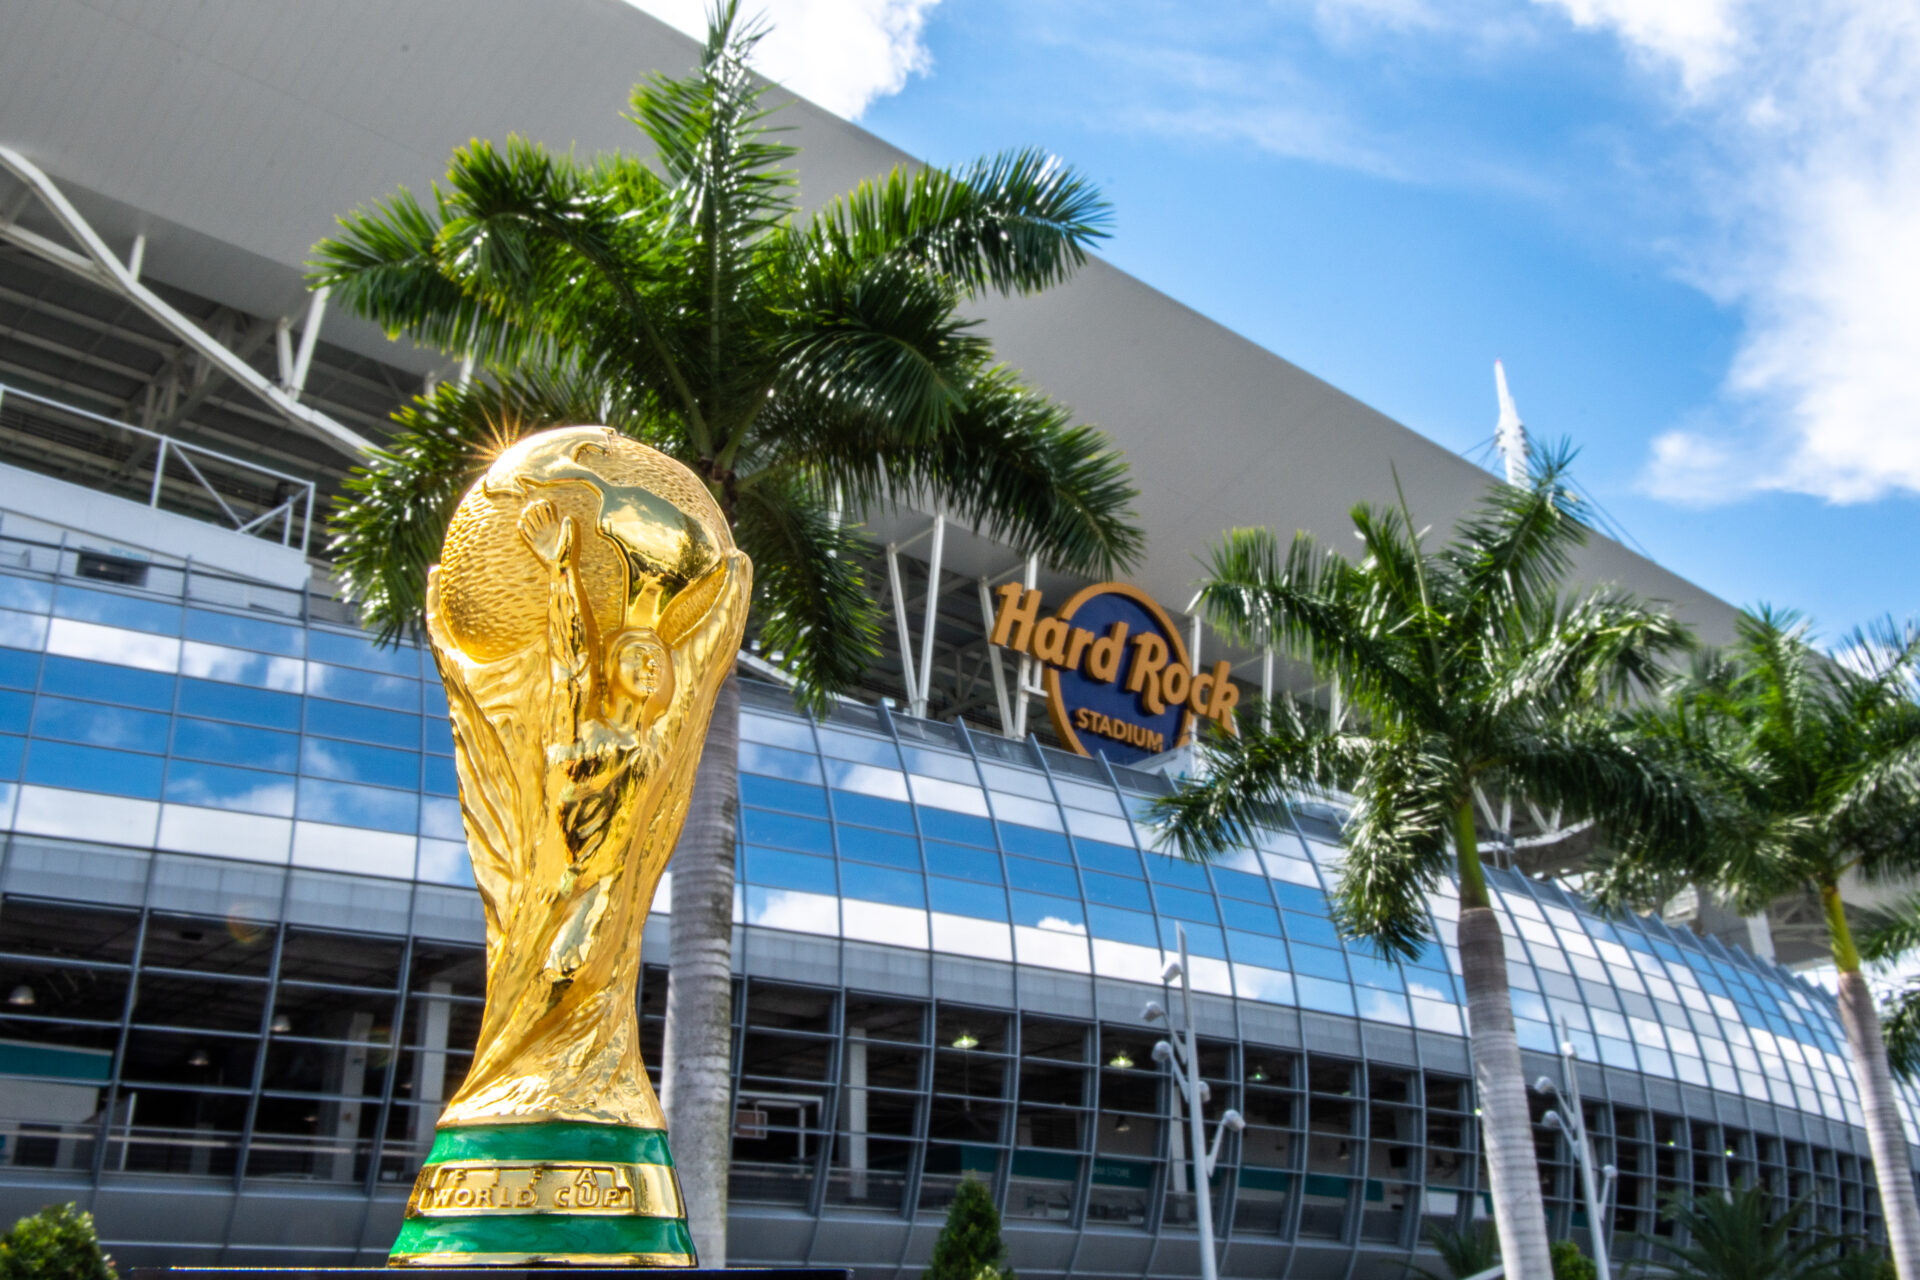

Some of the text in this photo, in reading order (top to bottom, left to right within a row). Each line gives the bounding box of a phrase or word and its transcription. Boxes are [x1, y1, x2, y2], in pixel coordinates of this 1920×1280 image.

[990, 581, 1239, 737] Hard Rock
[1074, 707, 1164, 753] STADIUM
[434, 1183, 625, 1208] WORLD CUP
